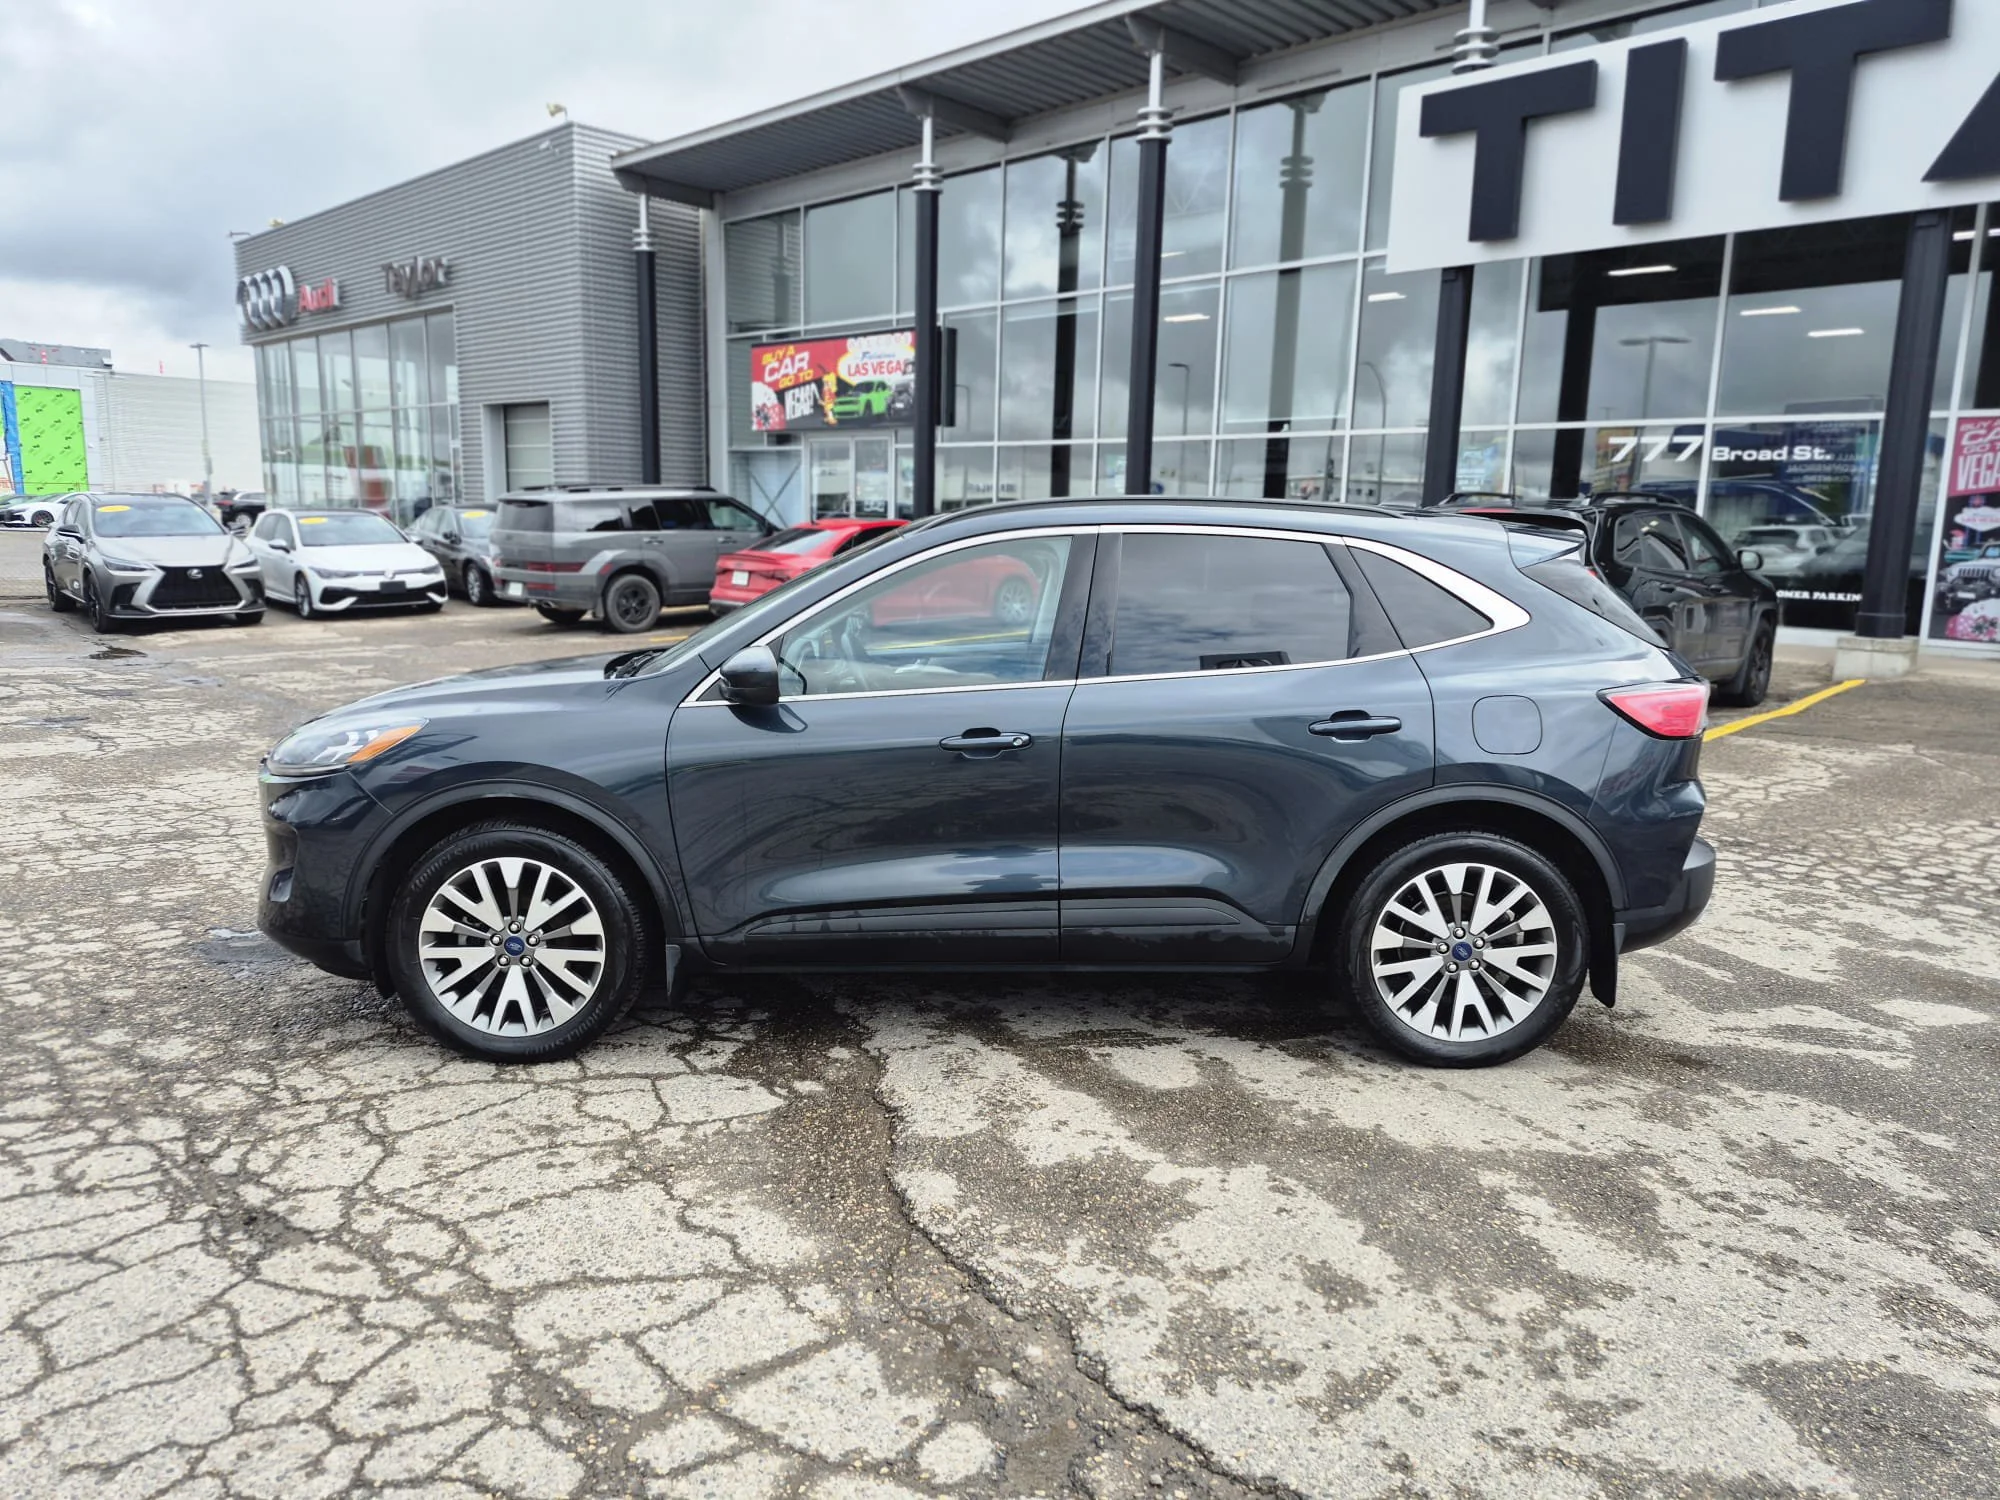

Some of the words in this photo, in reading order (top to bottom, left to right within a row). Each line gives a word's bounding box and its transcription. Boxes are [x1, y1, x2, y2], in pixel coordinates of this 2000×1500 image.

[300, 277, 339, 313] Audi
[761, 348, 785, 366] BUY
[785, 344, 796, 357] A
[764, 351, 811, 383] CAR
[778, 374, 796, 389] GO
[798, 369, 815, 383] TO
[847, 361, 869, 377] LAS
[1608, 435, 1705, 462] 777
[1711, 445, 1788, 462] Broad
[1792, 445, 1832, 461] St.
